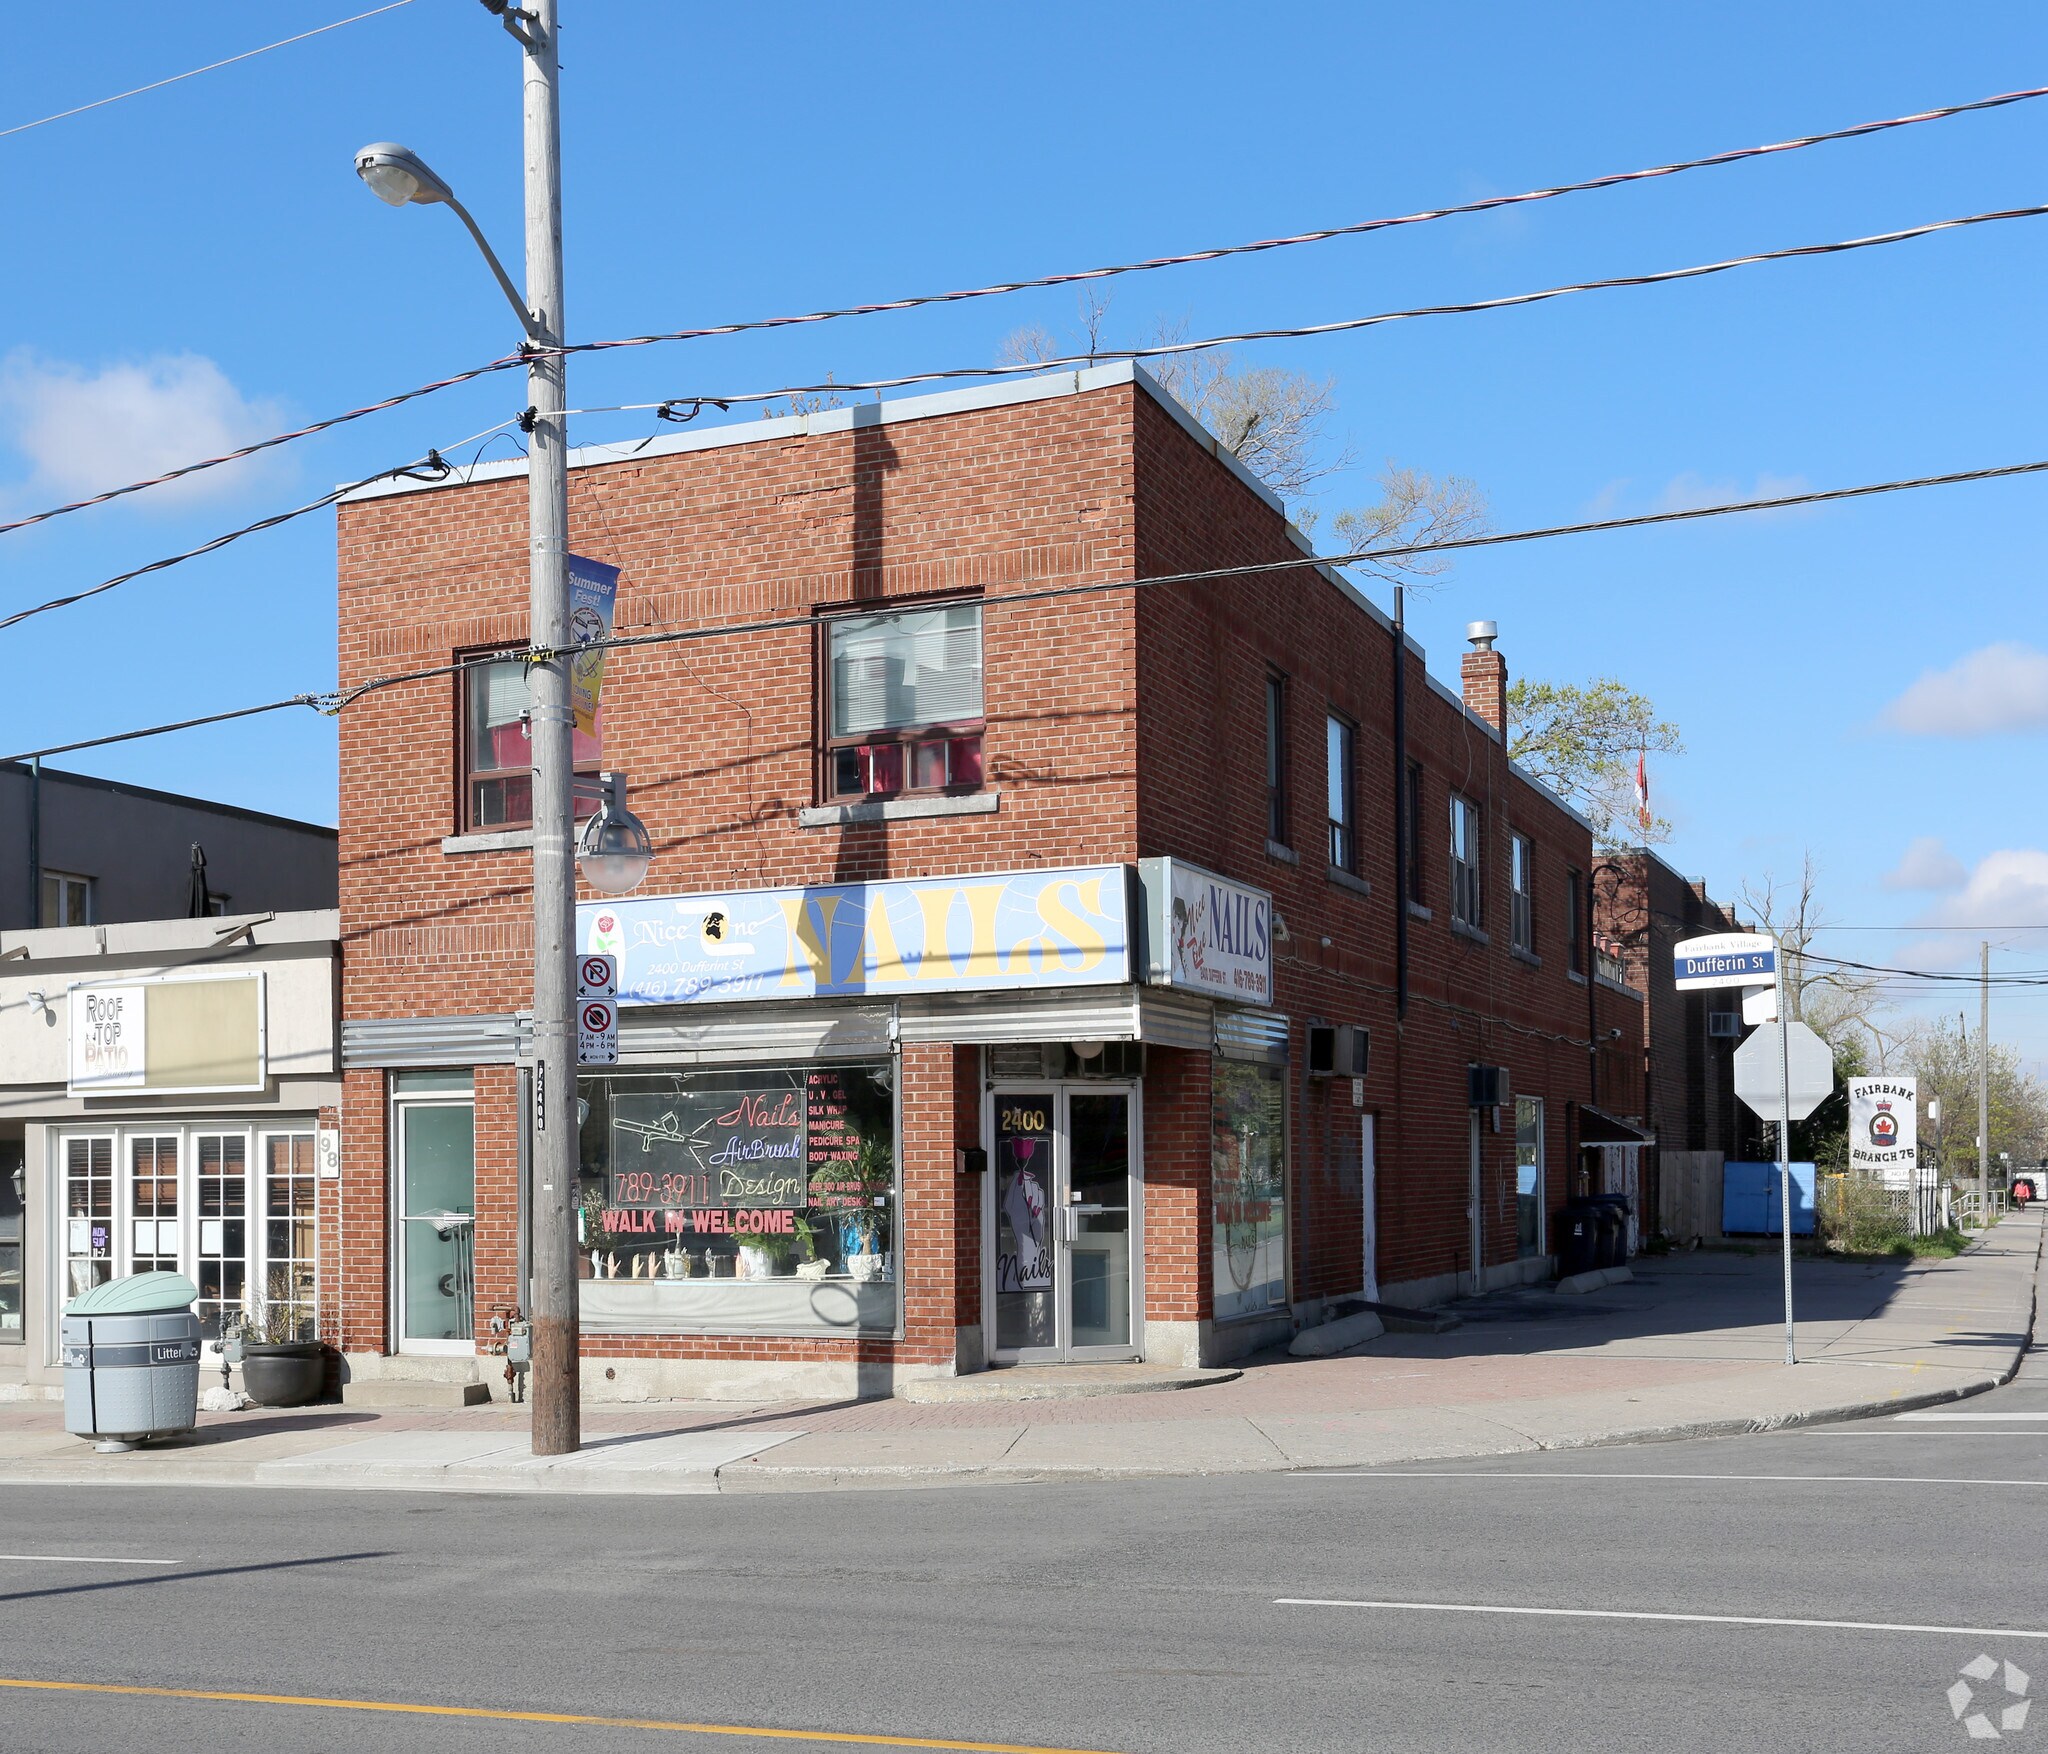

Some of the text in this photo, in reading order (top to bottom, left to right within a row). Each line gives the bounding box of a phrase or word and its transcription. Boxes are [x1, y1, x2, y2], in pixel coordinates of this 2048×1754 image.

[569, 571, 612, 596] Summer
[575, 589, 601, 607] Fest!
[776, 877, 1107, 988] NAILS
[1208, 884, 1267, 962] NAILS
[634, 919, 689, 948] Nice
[1685, 939, 1762, 953] Fairbank Village
[646, 962, 679, 976] 2400
[732, 958, 745, 971] St
[1687, 955, 1764, 975] Dufferin St
[629, 972, 765, 998] (416) 789-3911
[1712, 977, 1740, 986] 2400
[87, 994, 123, 1023] ROOF
[95, 1022, 121, 1046] TOP
[85, 1043, 129, 1072] PATIO
[808, 1074, 838, 1084] ACRYLIC
[833, 1089, 847, 1099] GEL
[1854, 1084, 1914, 1102] FAIRBANK
[717, 1093, 801, 1127] Nails
[808, 1105, 847, 1115] SILK WRAP
[808, 1120, 845, 1130] MANICURE
[1002, 1110, 1045, 1131] 2400
[709, 1134, 801, 1167] AirBrush
[808, 1135, 860, 1146] PEDICURE SPA
[808, 1151, 858, 1161] BODY WAXING
[1853, 1148, 1897, 1163] BRANCH
[615, 1172, 707, 1205] 789-3911
[720, 1169, 801, 1205] Design
[808, 1196, 823, 1207] NAIL
[825, 1196, 840, 1206] ART
[601, 1209, 795, 1233] WALK IN WELCOME
[92, 1247, 106, 1257] 11-7
[996, 1248, 1054, 1291] Nails
[157, 1347, 182, 1360] Litter
